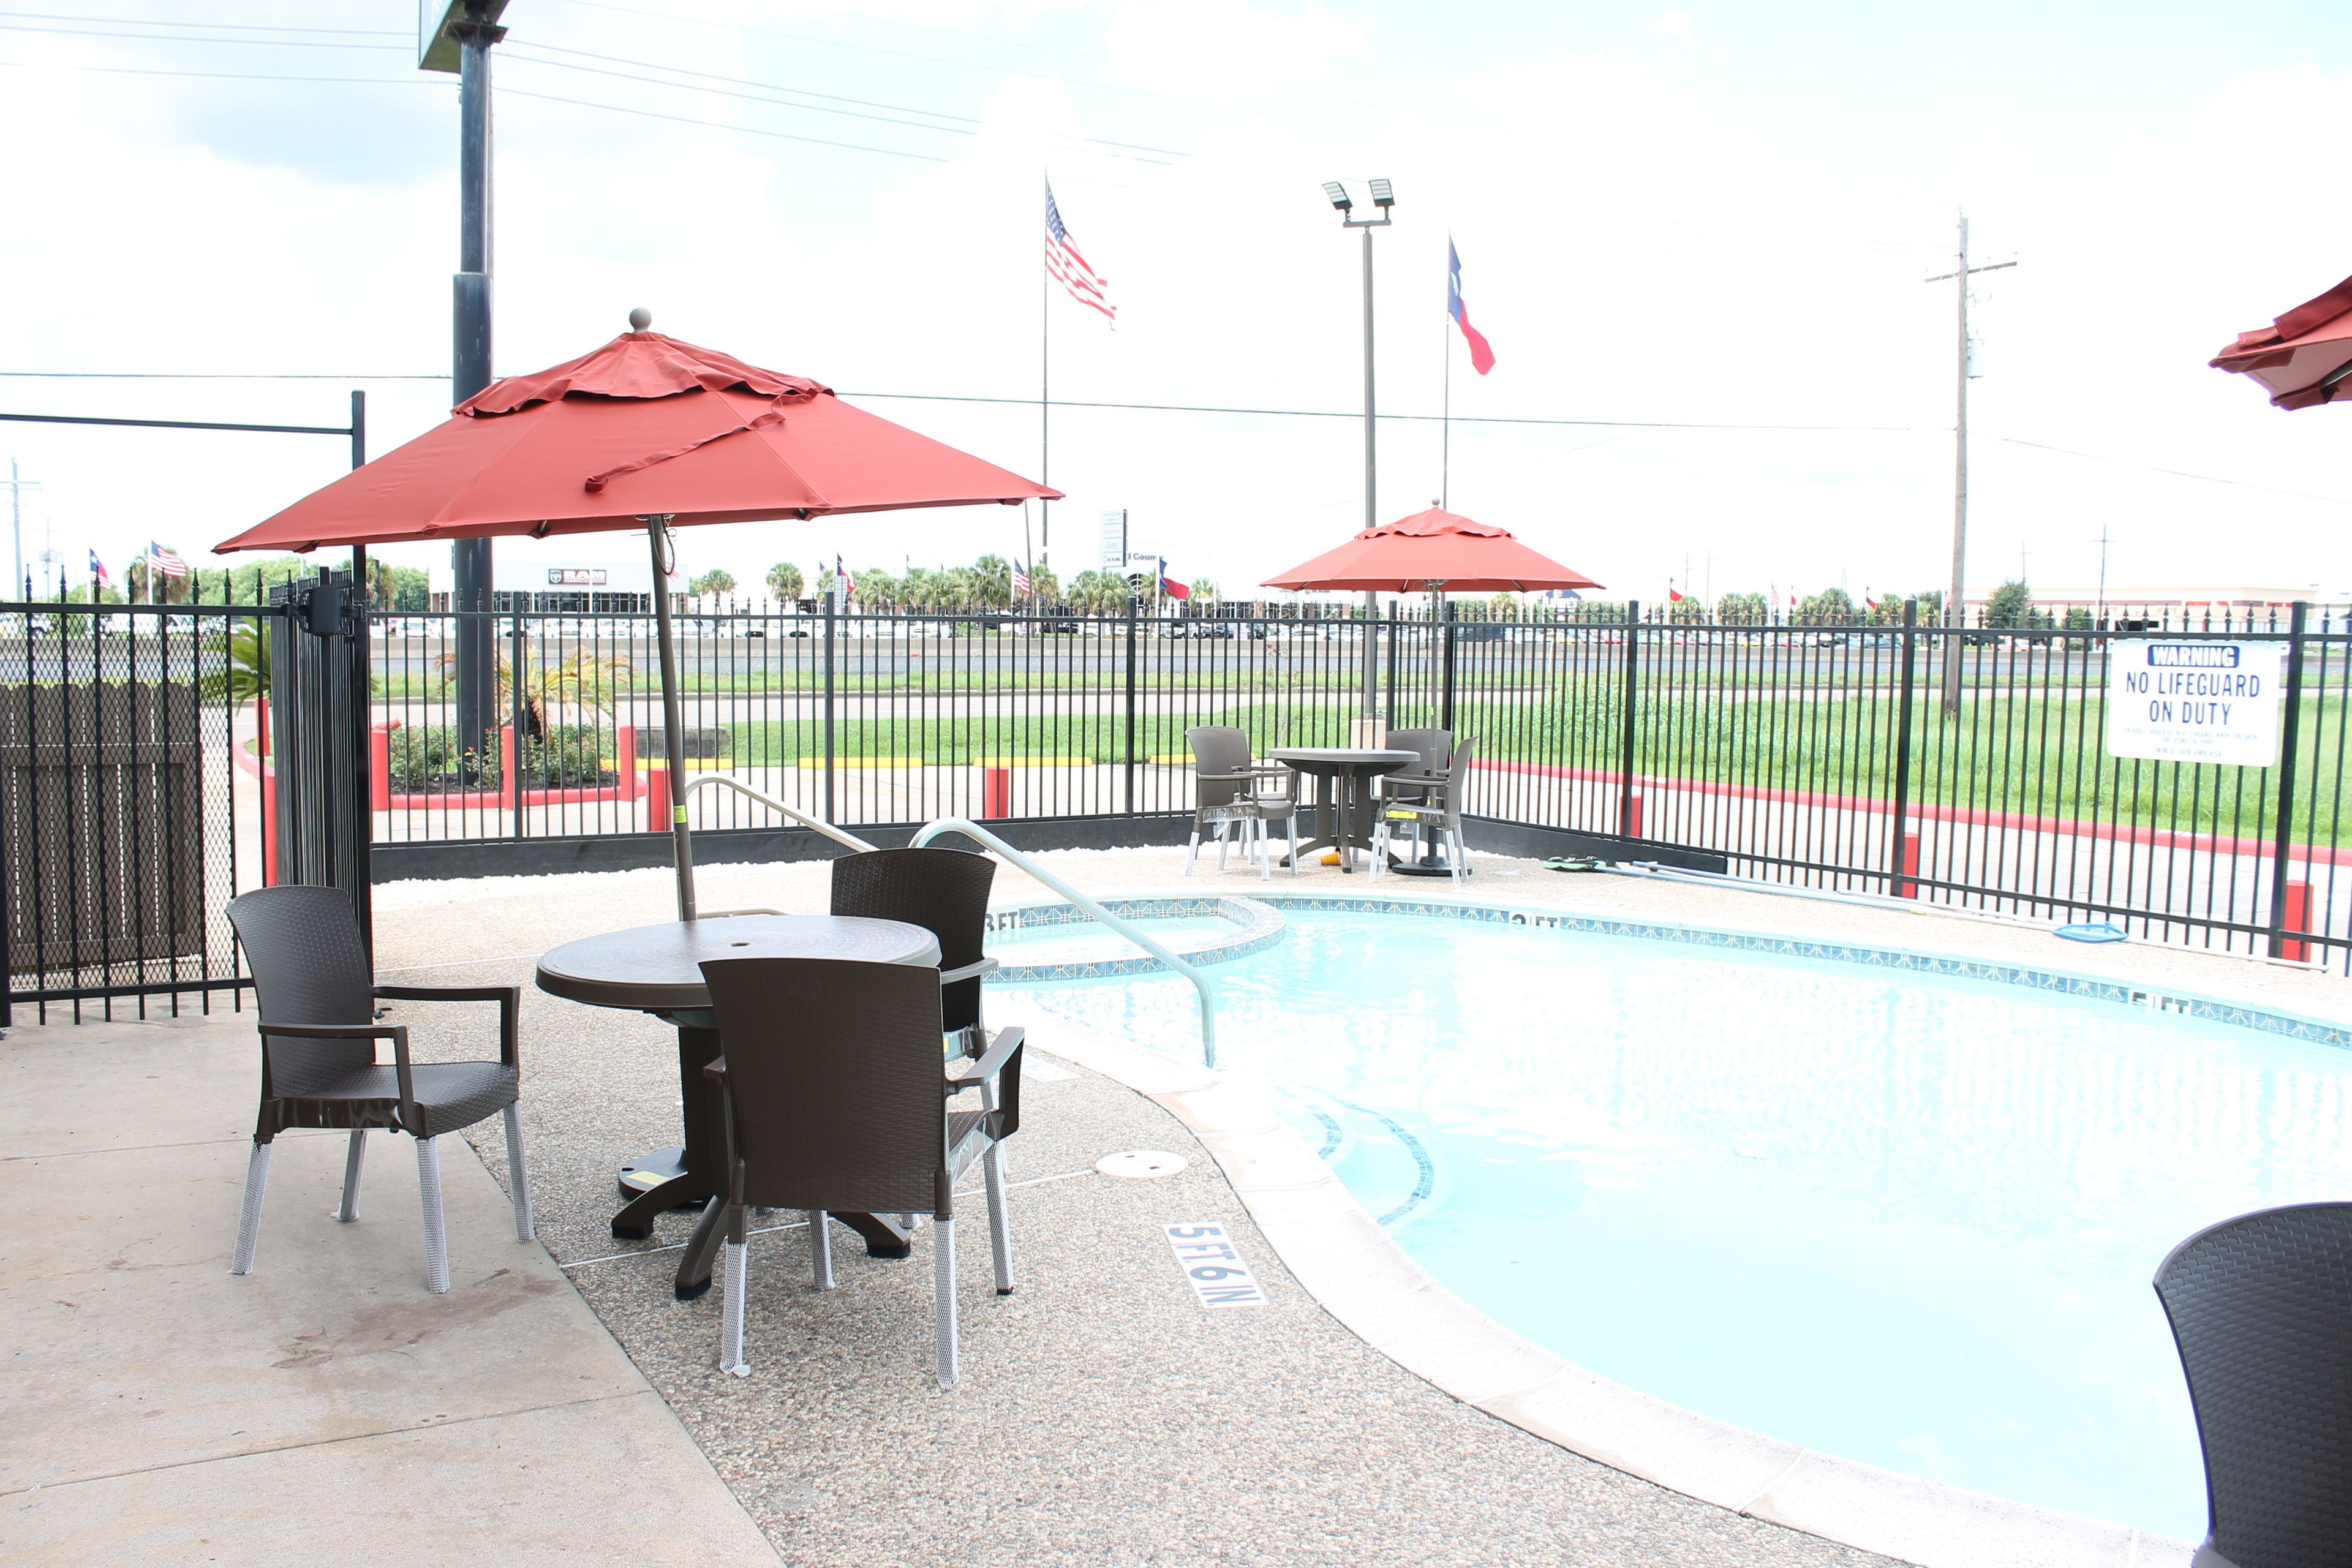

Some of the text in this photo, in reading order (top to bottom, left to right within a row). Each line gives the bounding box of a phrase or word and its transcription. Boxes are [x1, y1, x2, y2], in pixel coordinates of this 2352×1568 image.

[564, 570, 606, 579] RAM
[2152, 646, 2236, 668] WARNING
[2125, 671, 2261, 697] NO LIFEGUARD
[2149, 699, 2232, 725] ON DUTY
